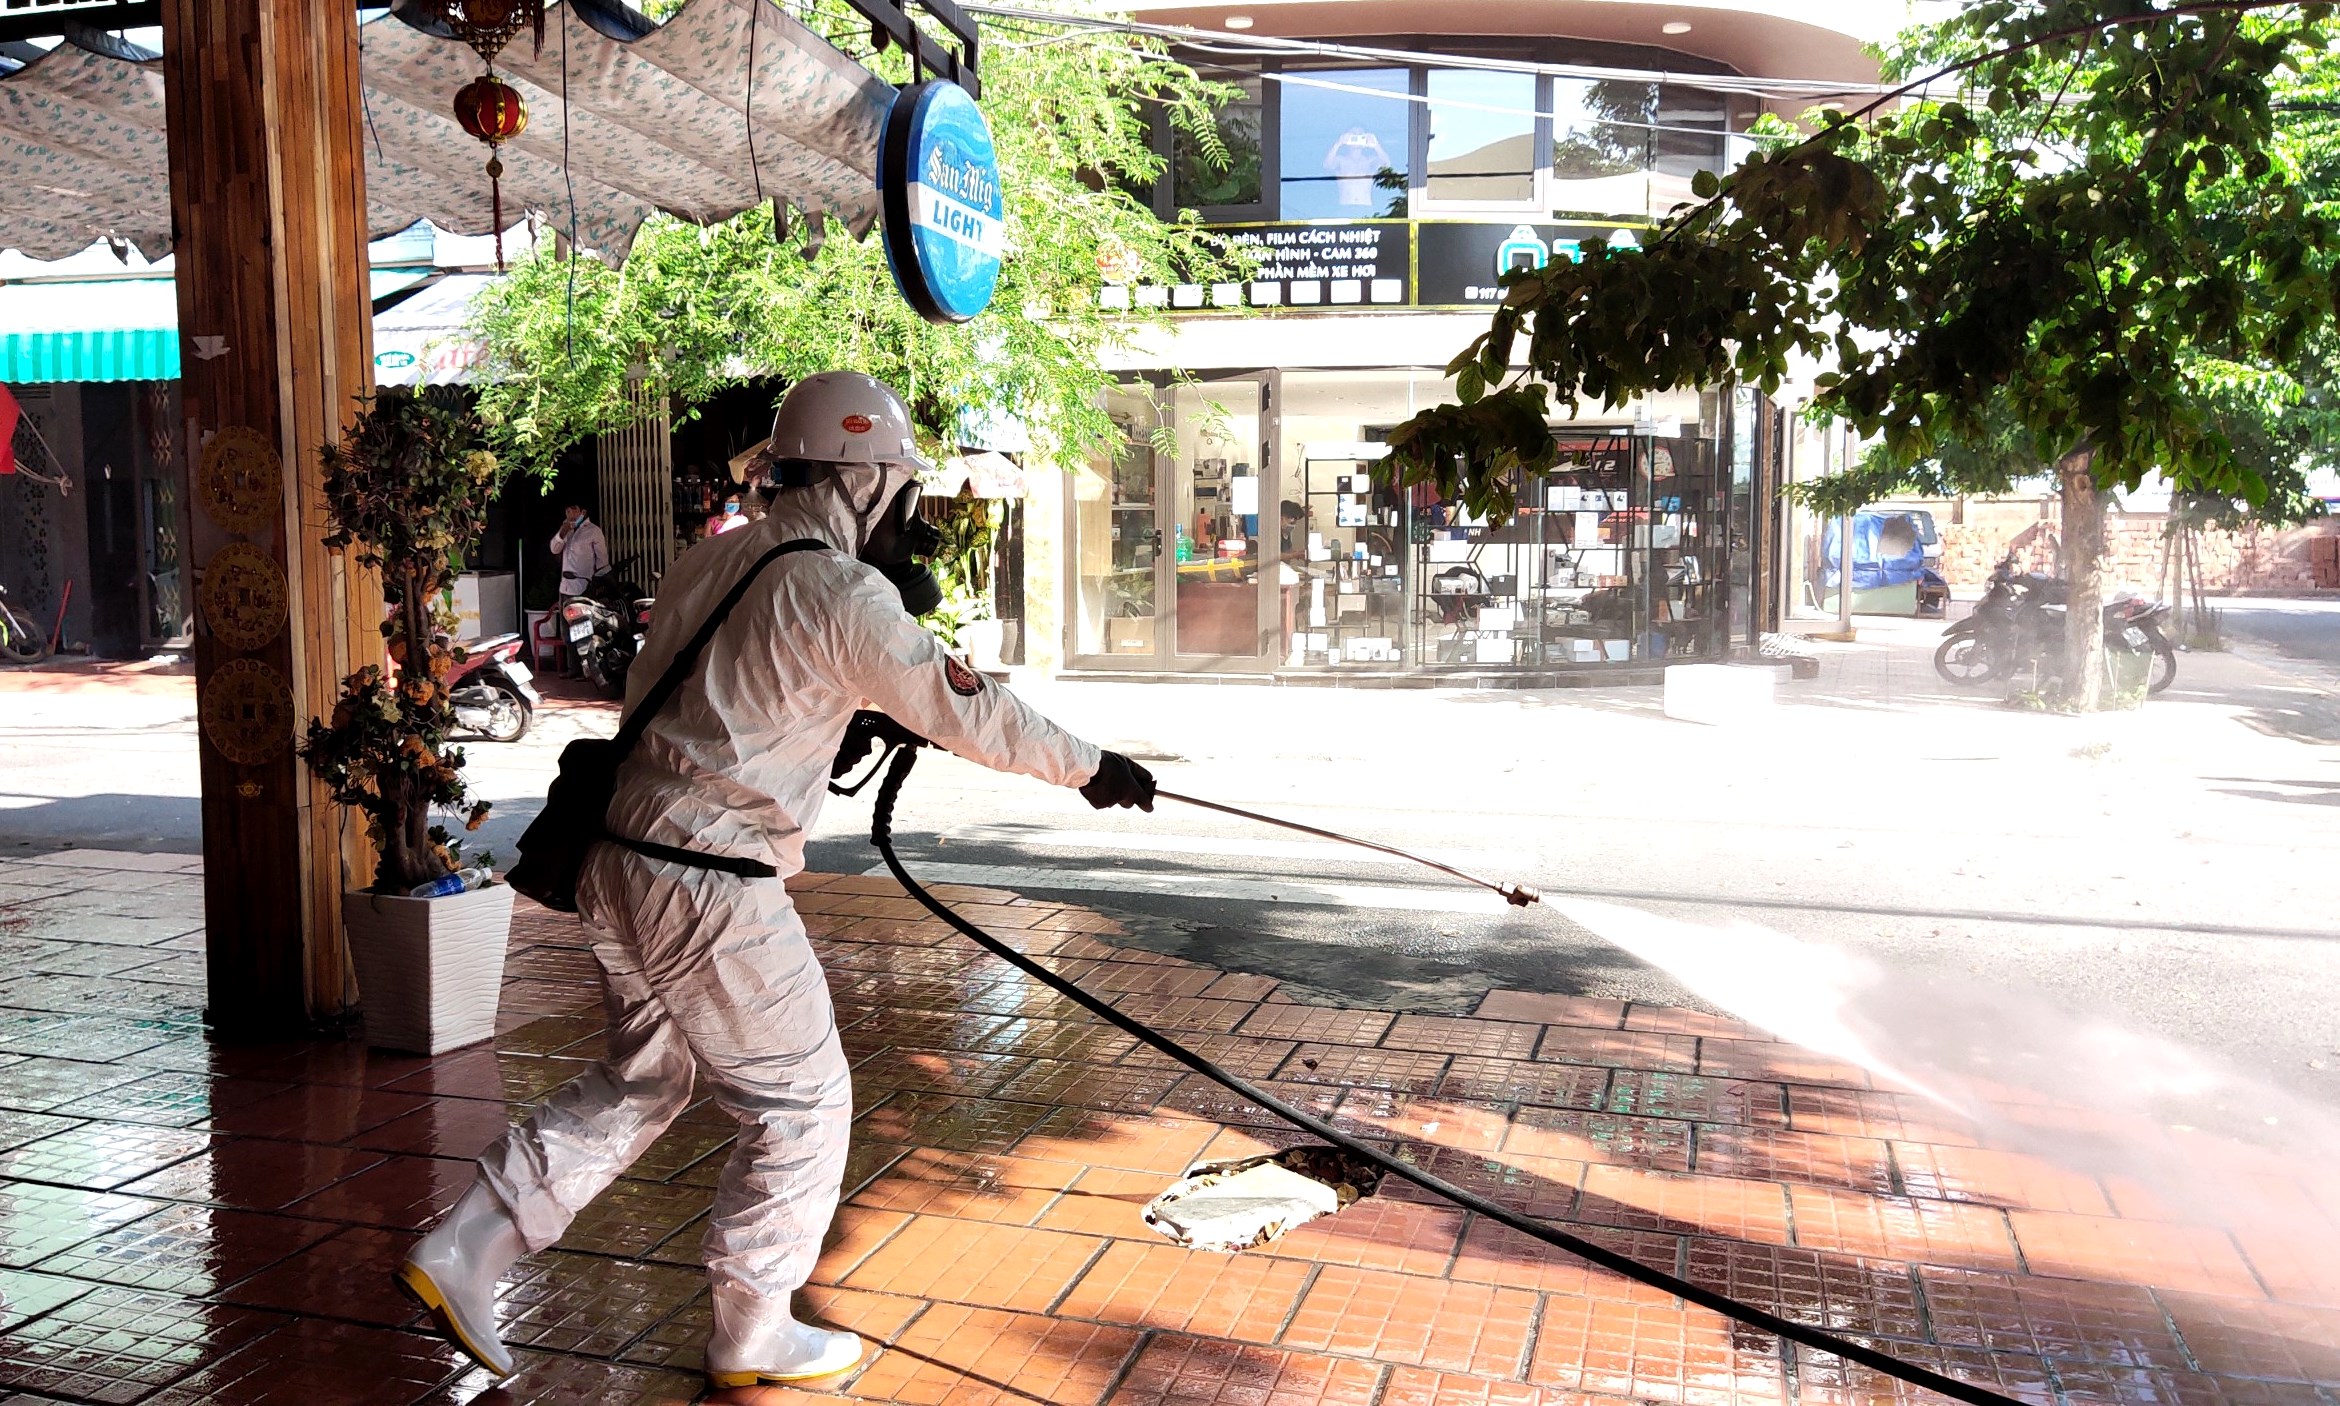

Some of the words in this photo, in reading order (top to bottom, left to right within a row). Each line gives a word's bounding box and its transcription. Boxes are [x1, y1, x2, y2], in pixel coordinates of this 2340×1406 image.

[928, 145, 960, 194] San
[959, 159, 993, 213] Mig
[933, 199, 984, 241] LIGHT
[1266, 231, 1297, 245] FILM
[1298, 229, 1336, 244] CÁCH
[1339, 228, 1381, 245] NHIỆT
[1275, 246, 1311, 261] HÌNH
[1321, 246, 1352, 260] CAM
[1354, 246, 1378, 259] 360
[1331, 265, 1349, 278] XE
[1351, 264, 1376, 278] HƠI
